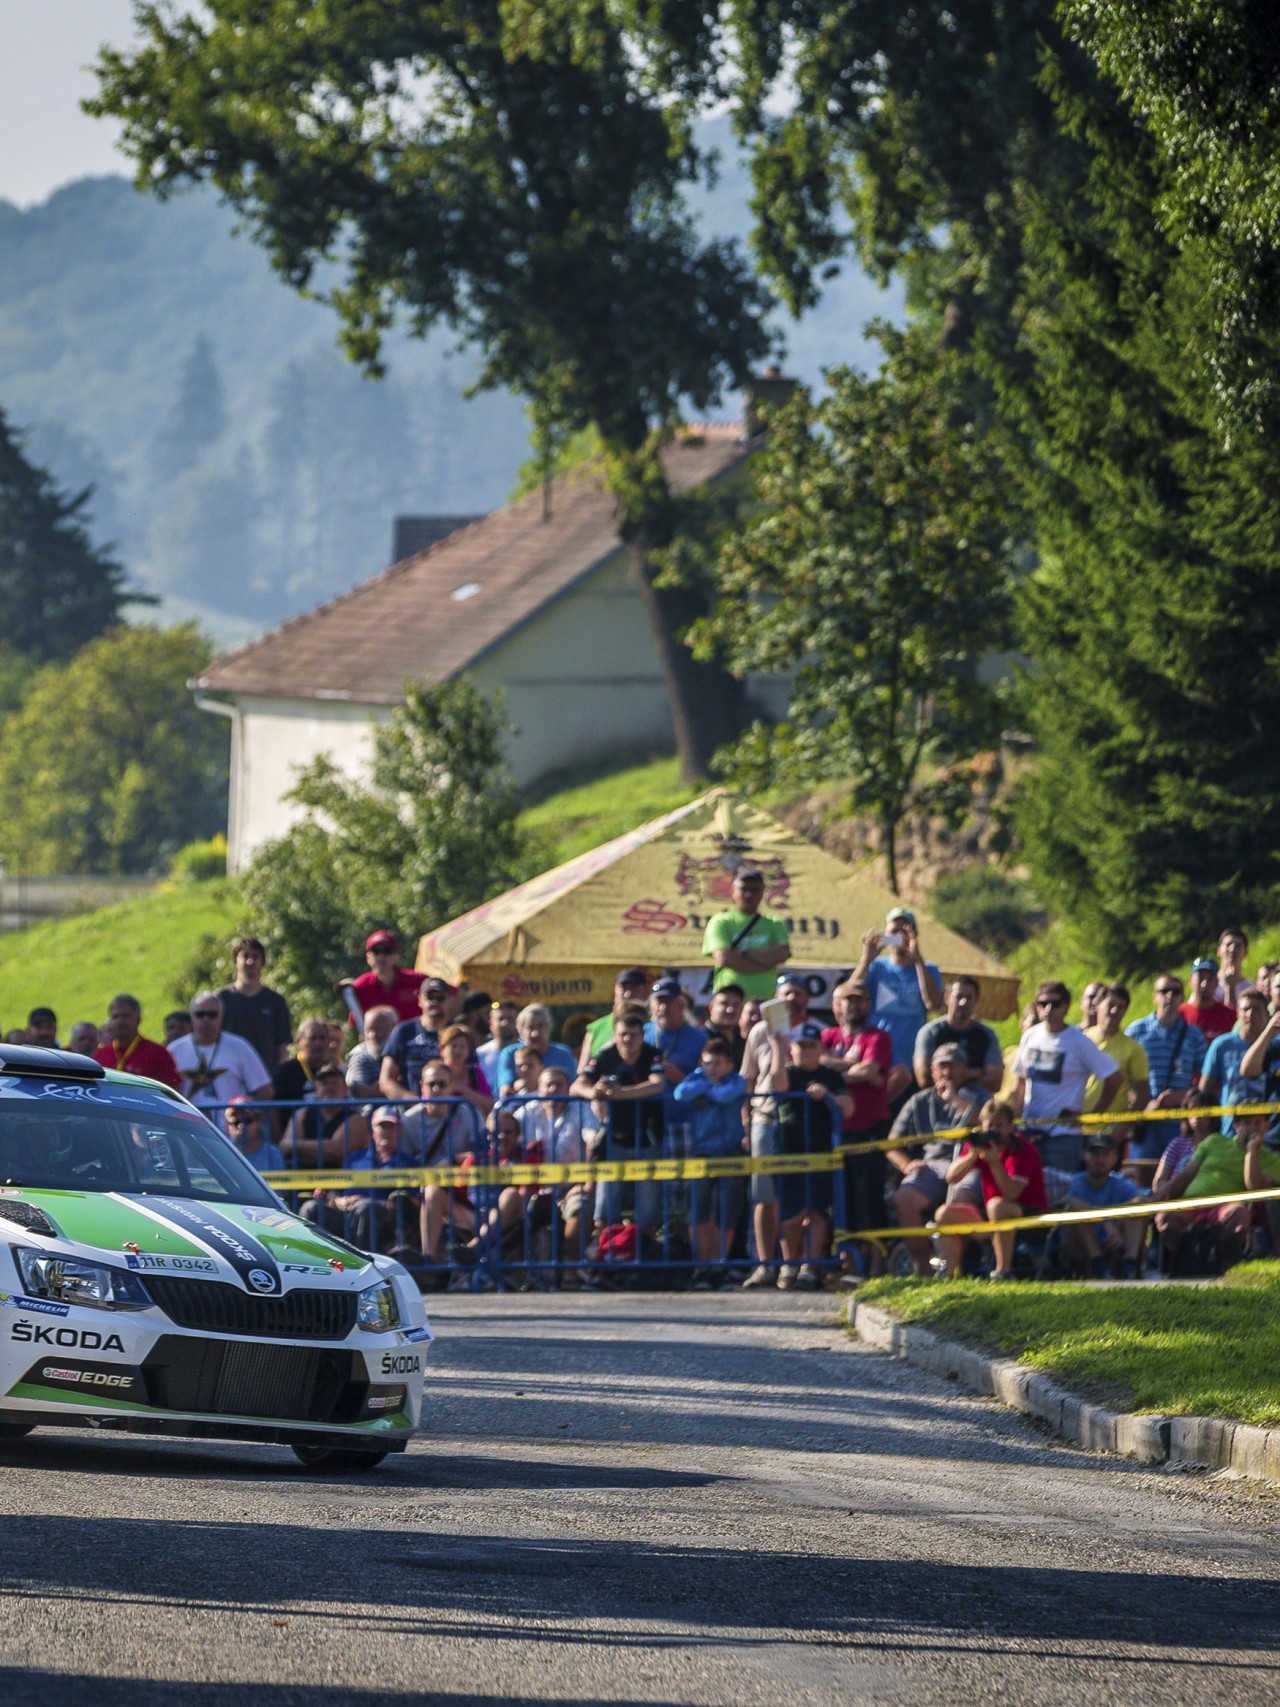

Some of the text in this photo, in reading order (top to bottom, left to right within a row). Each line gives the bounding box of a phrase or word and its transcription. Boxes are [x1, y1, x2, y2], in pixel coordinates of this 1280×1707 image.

[172, 1259, 214, 1271] 0342
[283, 1264, 332, 1276] R5
[19, 1300, 69, 1314] MICHELIN
[10, 1319, 126, 1354] ŠKODA
[381, 1352, 421, 1375] ŠKODA
[51, 1369, 135, 1388] Castrol EDGE
